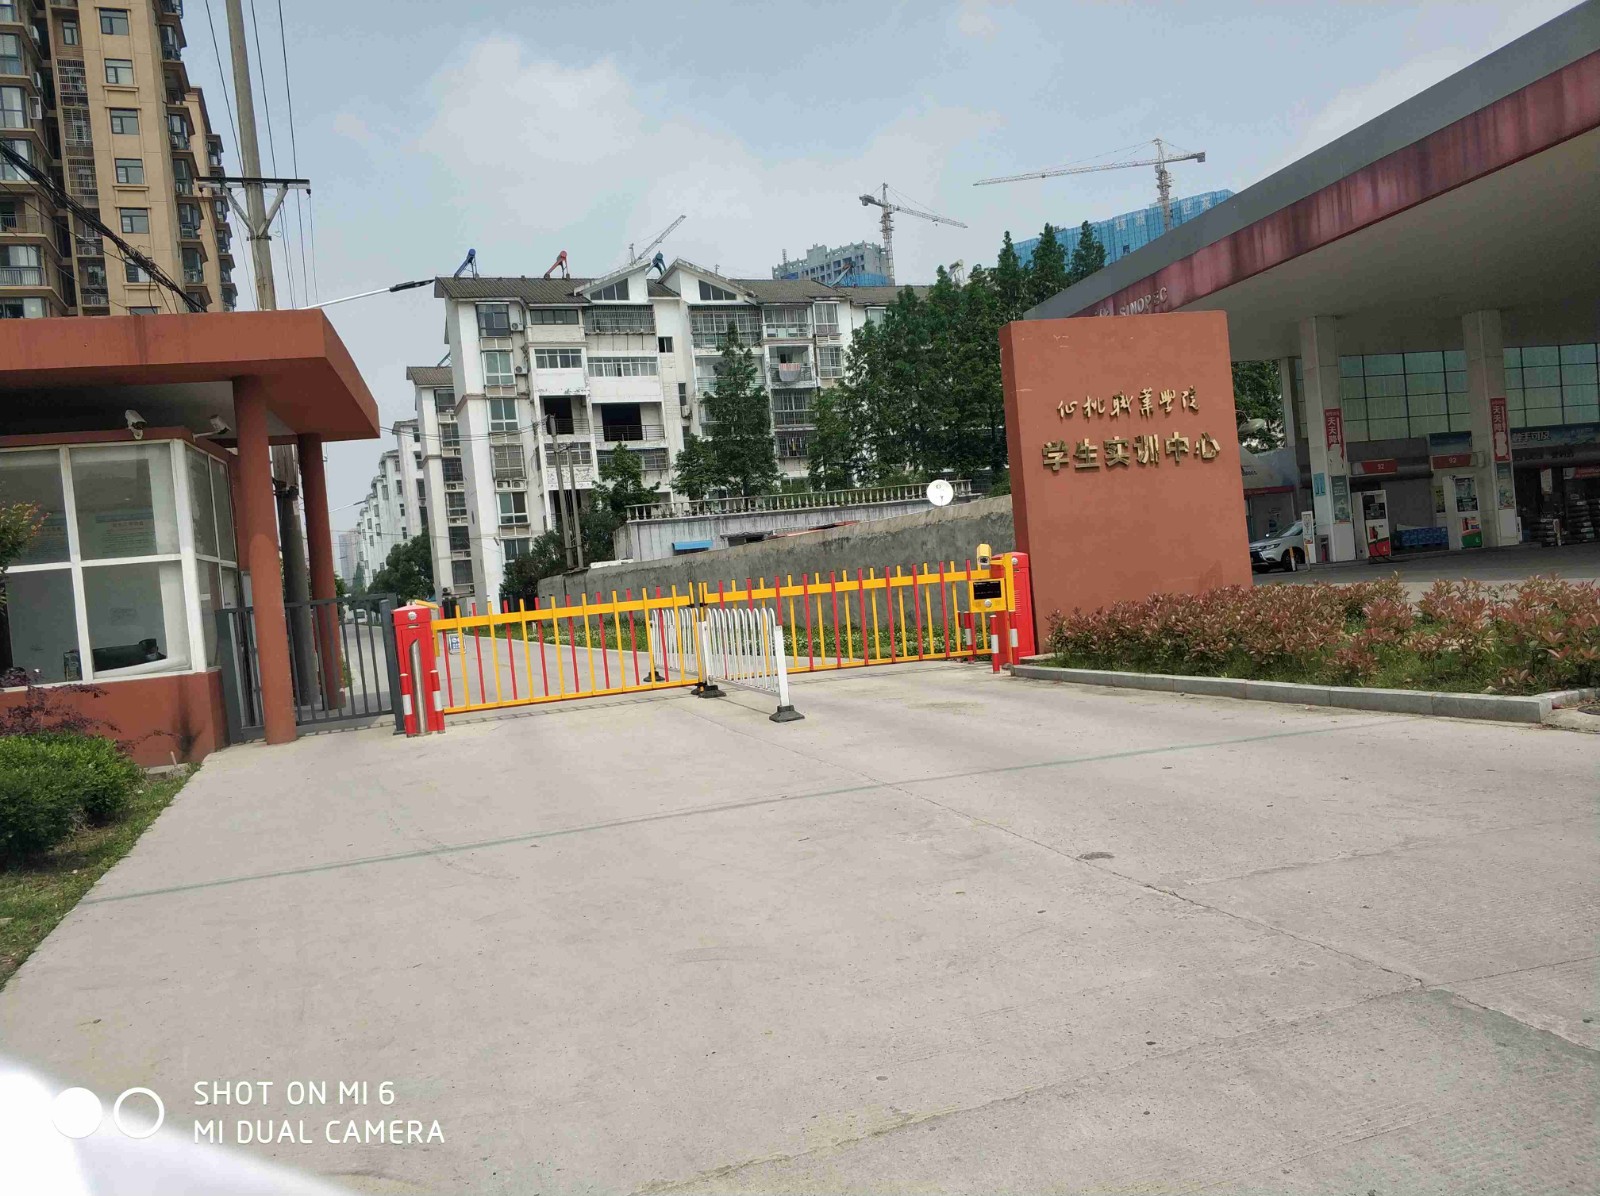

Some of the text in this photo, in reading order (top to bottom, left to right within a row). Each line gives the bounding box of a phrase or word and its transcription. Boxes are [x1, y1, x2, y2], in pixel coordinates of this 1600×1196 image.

[1042, 432, 1221, 471] 学生实训中心
